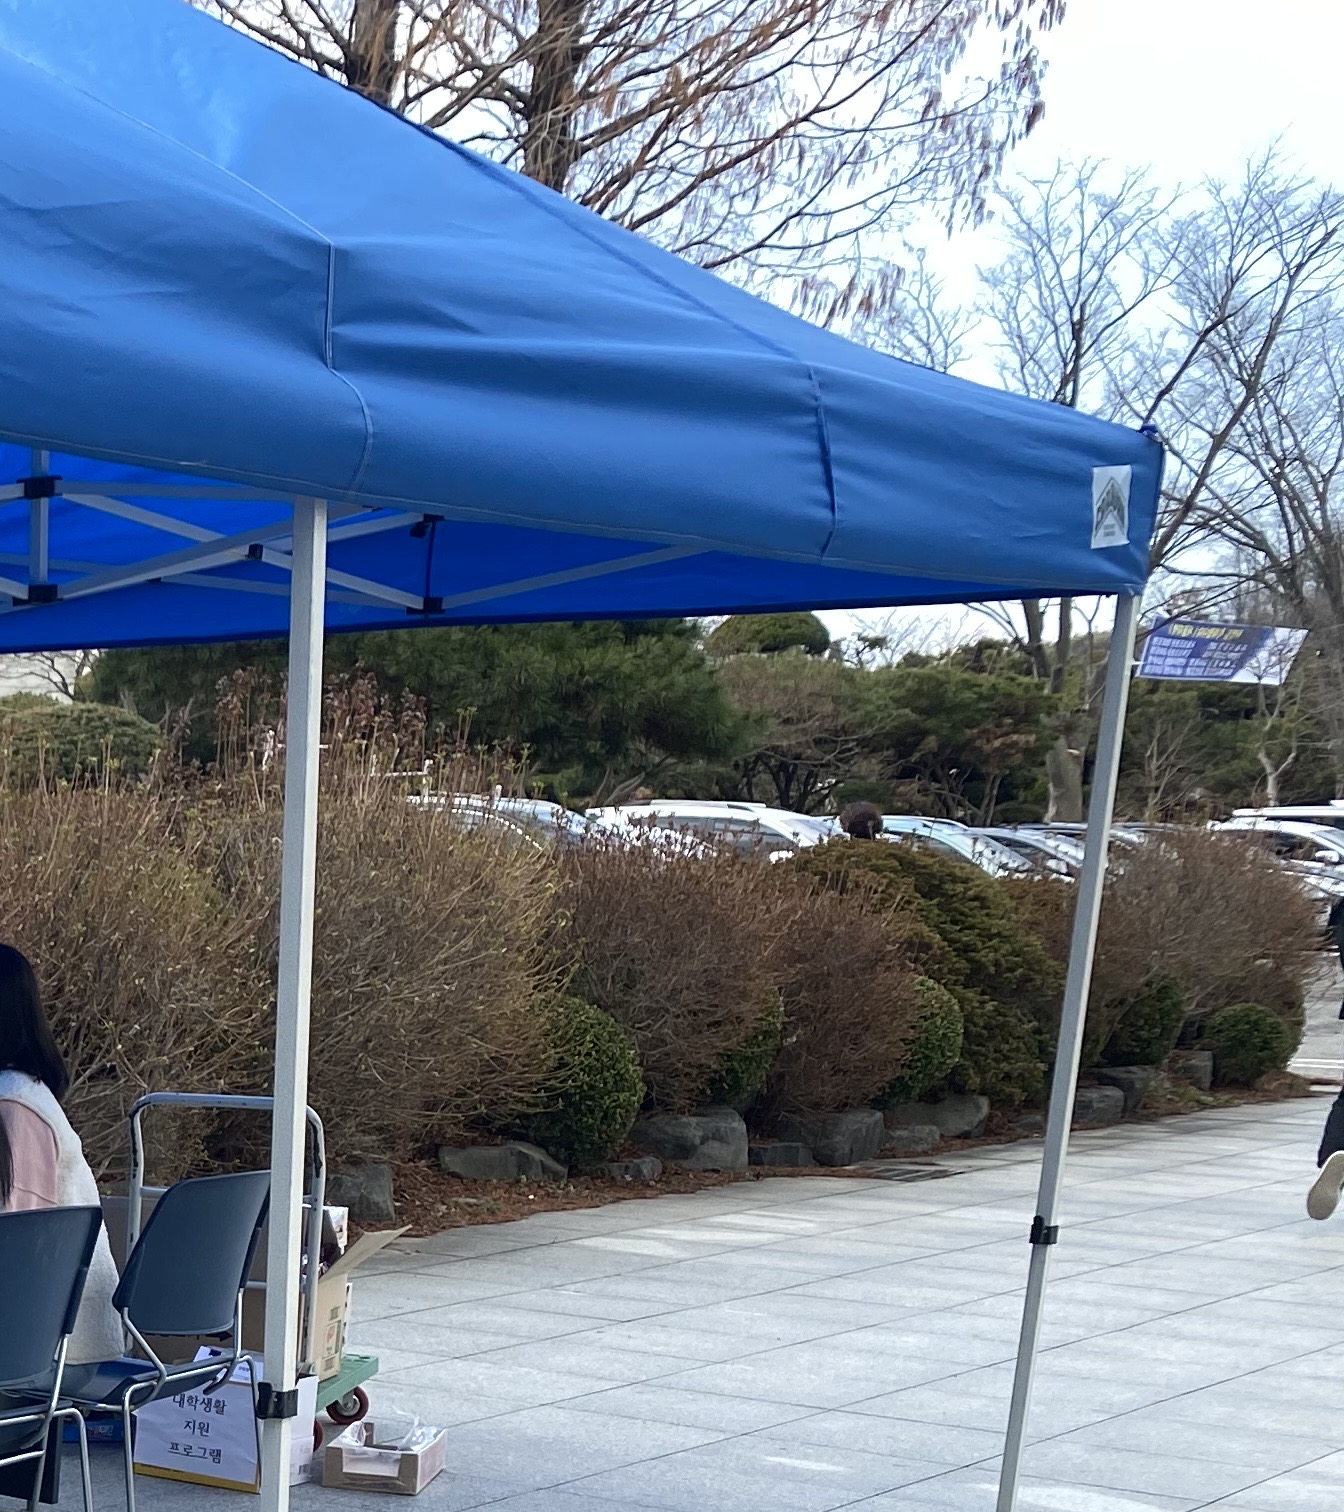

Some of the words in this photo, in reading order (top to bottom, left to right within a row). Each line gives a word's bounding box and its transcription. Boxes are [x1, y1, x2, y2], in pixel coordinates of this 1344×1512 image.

[172, 1393, 227, 1416] 대학생활
[183, 1420, 210, 1438] 지원
[168, 1441, 223, 1465] 프로그램
